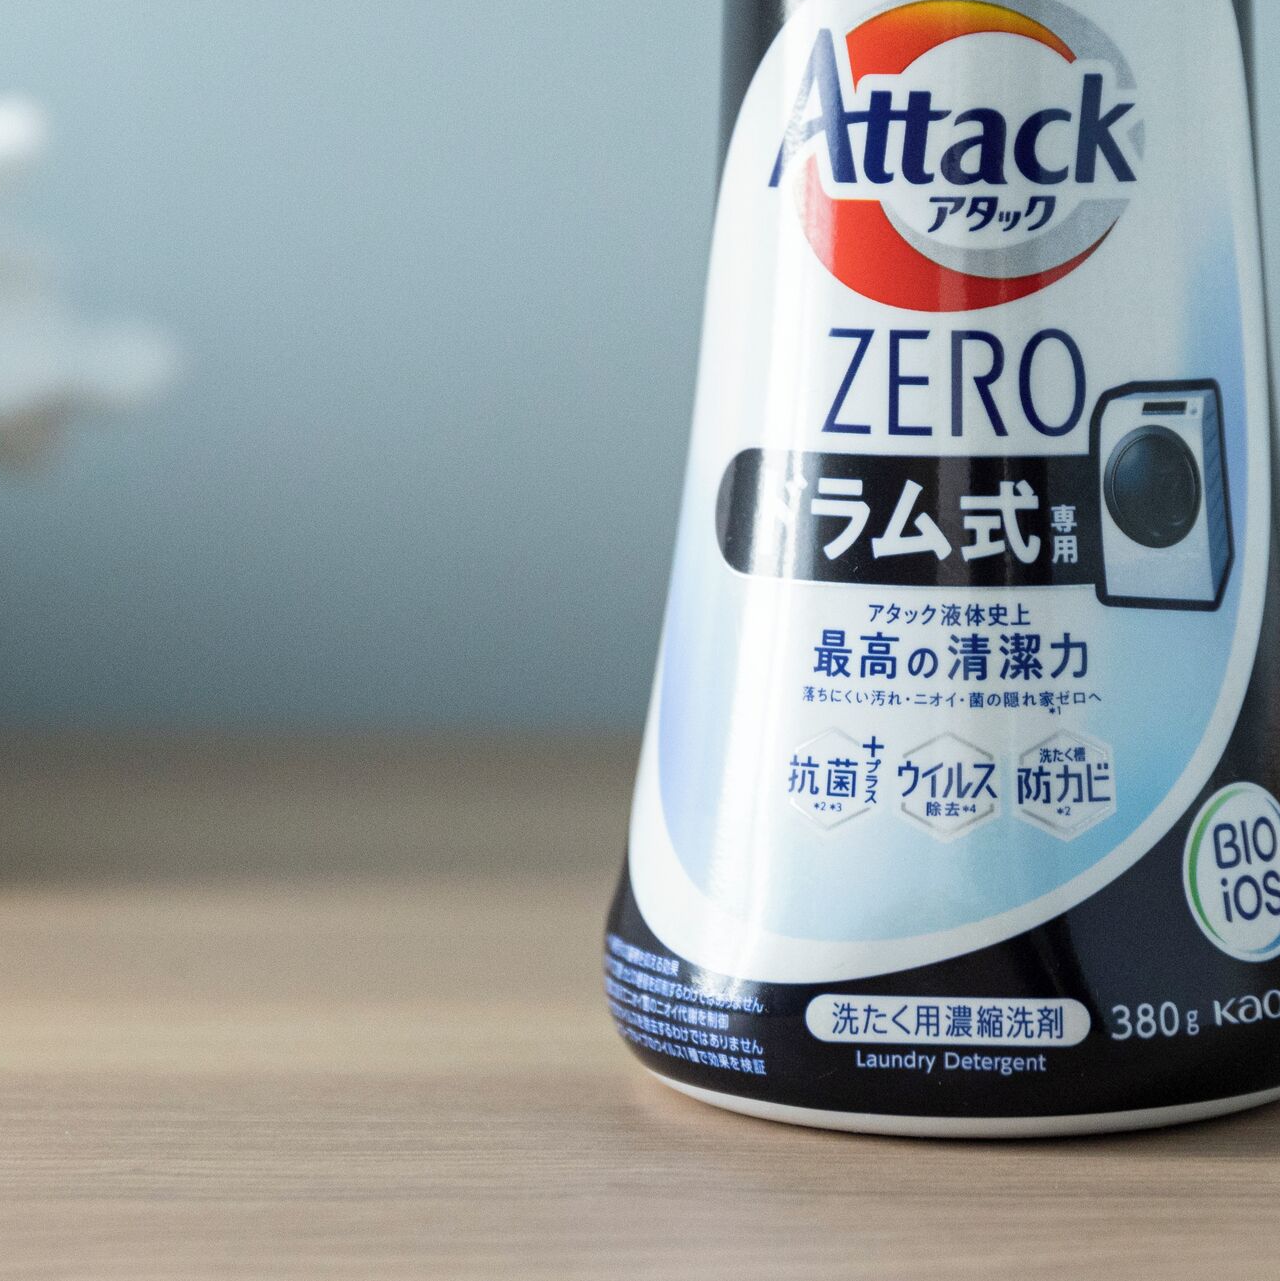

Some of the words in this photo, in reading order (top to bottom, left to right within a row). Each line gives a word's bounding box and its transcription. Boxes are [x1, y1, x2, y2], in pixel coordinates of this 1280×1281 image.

[768, 27, 1137, 188] Attack
[927, 194, 1057, 233] アタック
[821, 328, 1086, 438] ZERO
[1050, 503, 1079, 565] 専用
[868, 602, 1031, 627] アタック液体史上
[813, 629, 1089, 681] 最高の清潔力
[788, 754, 858, 798] 抗菌
[1039, 747, 1086, 764] 洗たく槽
[864, 759, 882, 804] プラス
[897, 760, 998, 799] ウイルス
[1017, 763, 1112, 805] 防カビ
[1212, 815, 1278, 870] BIO
[831, 1003, 1065, 1039] 洗たく用濃縮洗剤
[856, 1050, 936, 1074] Laundry
[944, 1051, 1048, 1076] Detergent
